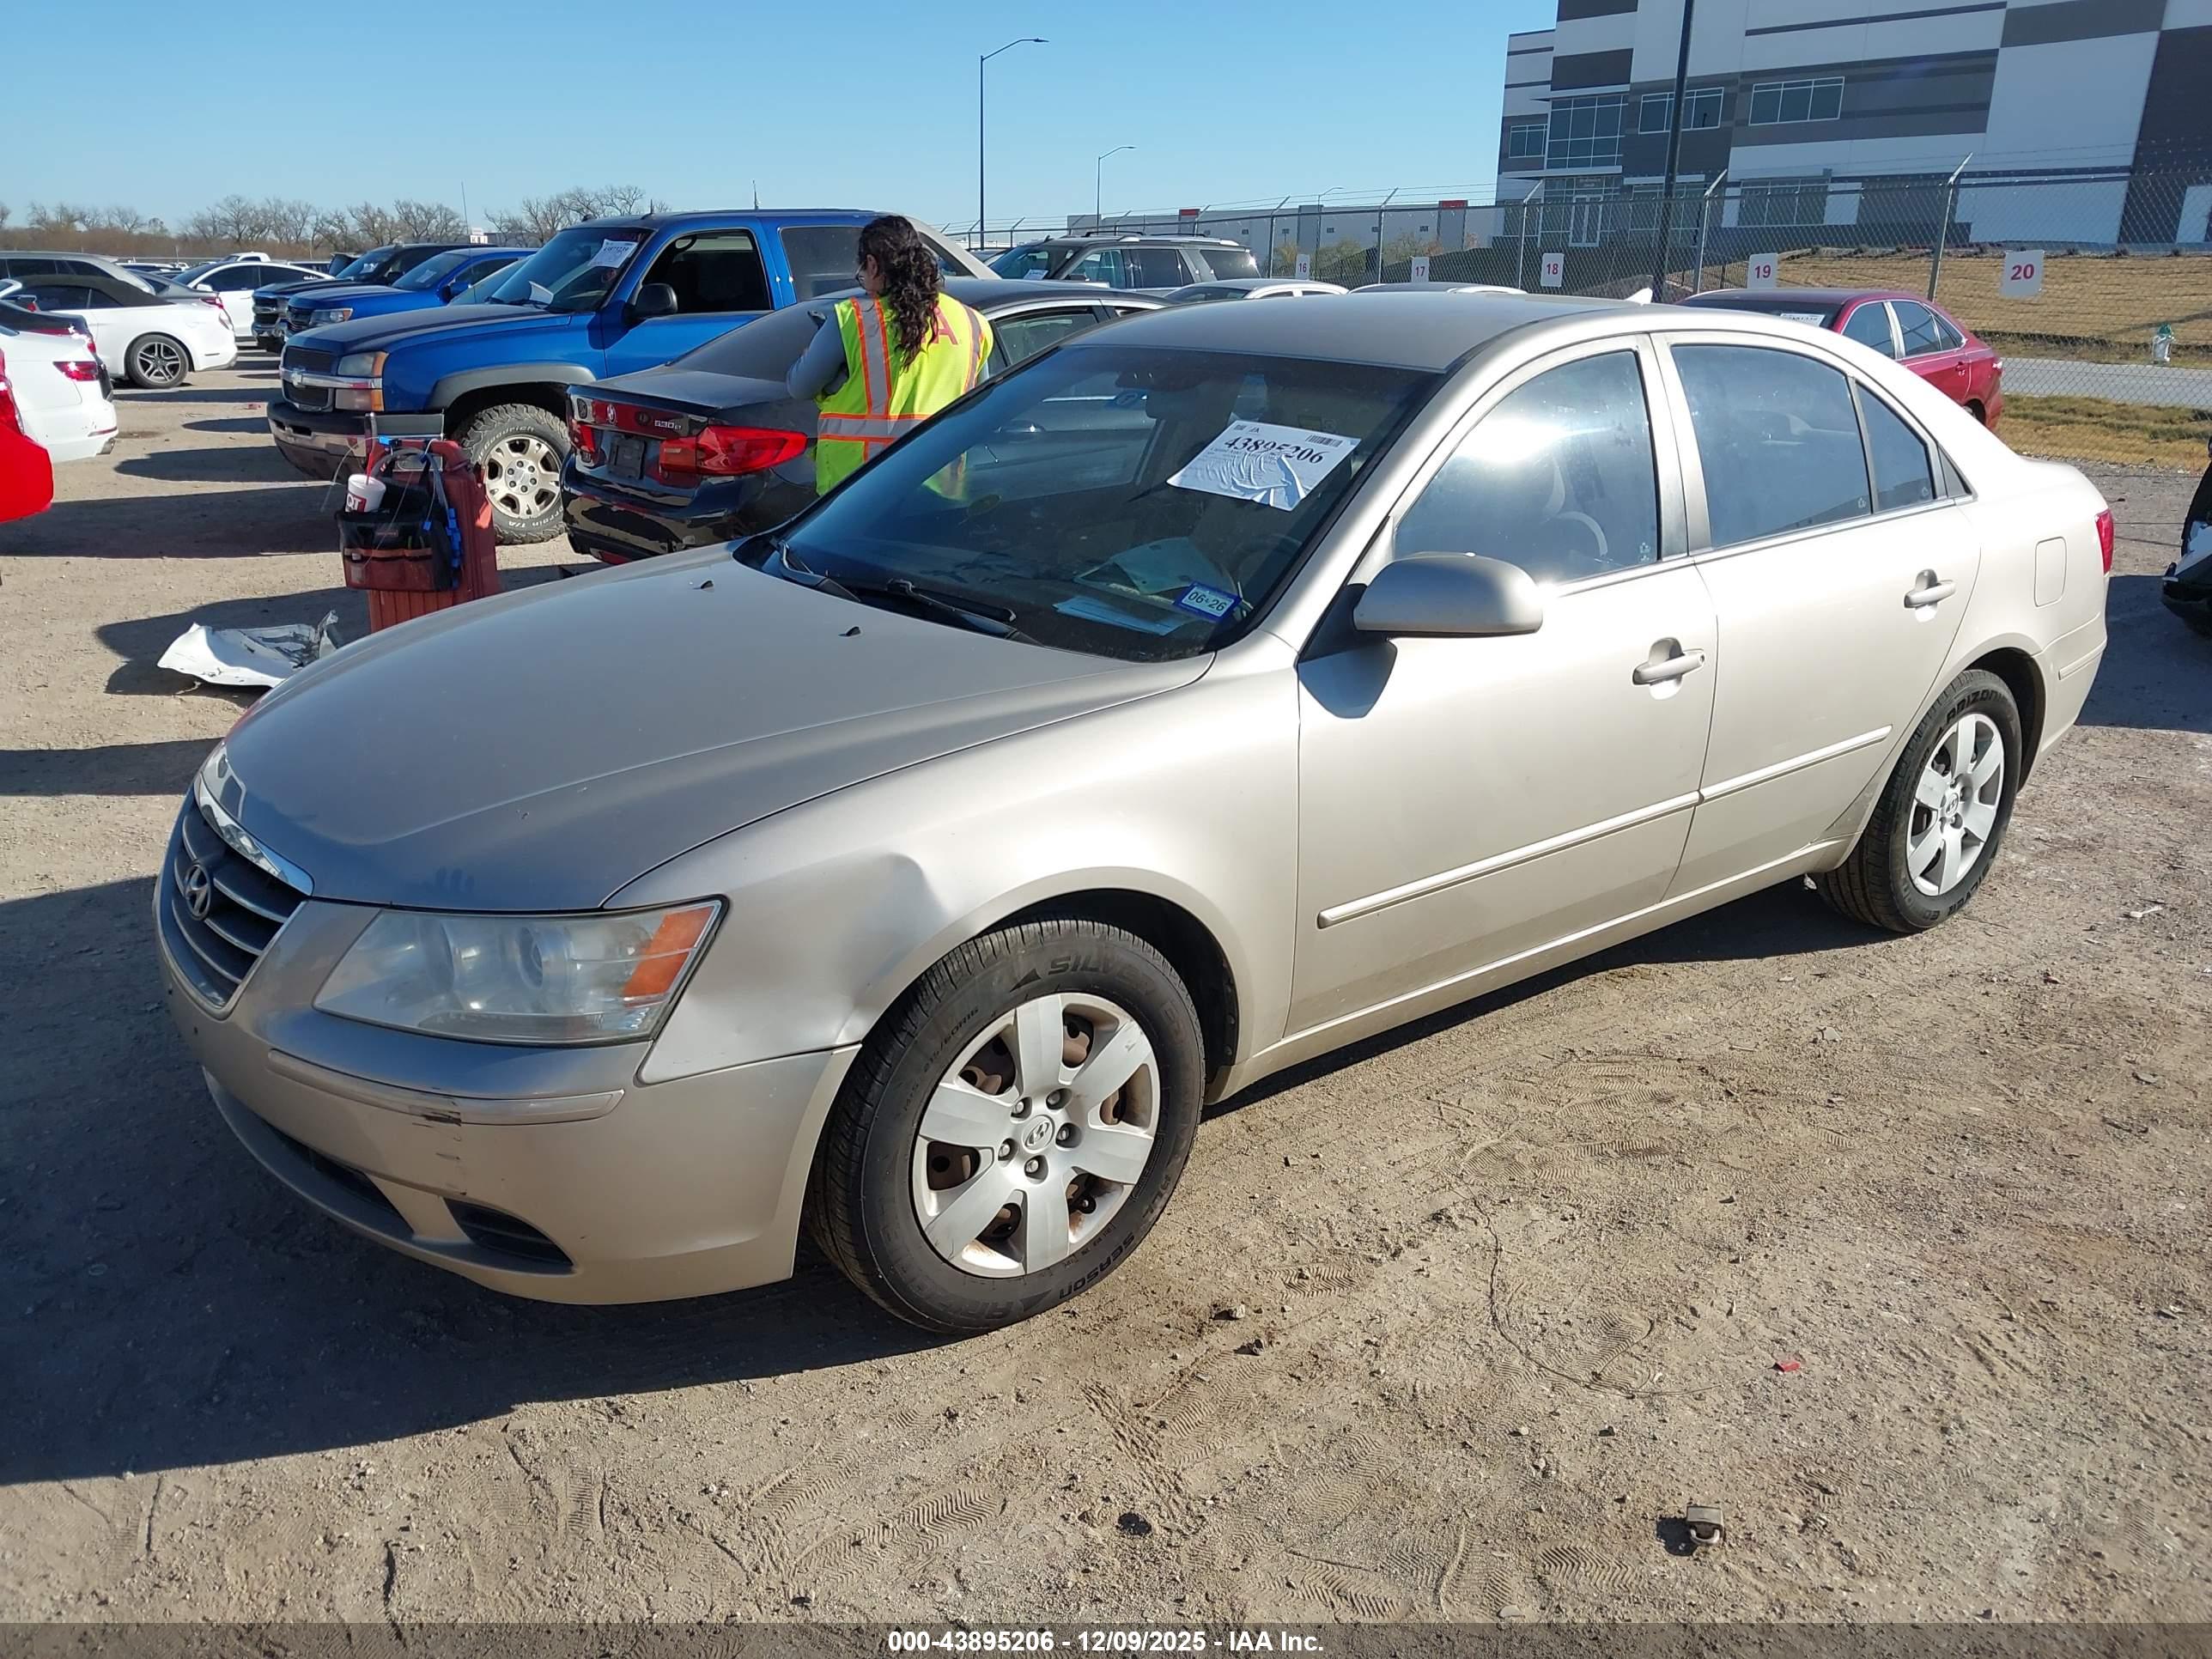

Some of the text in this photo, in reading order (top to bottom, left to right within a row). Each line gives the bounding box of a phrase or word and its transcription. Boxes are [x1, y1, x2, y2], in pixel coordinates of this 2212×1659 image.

[1298, 263, 1308, 273] 16
[1415, 266, 1425, 277] 17
[1547, 263, 1559, 276] 18
[1754, 264, 1771, 279] 19
[2010, 264, 2035, 281] 20
[1223, 436, 1331, 465] 43895206
[346, 494, 362, 510] QT
[1188, 592, 1227, 611] 06 26
[1058, 1231, 1136, 1300] SEASON
